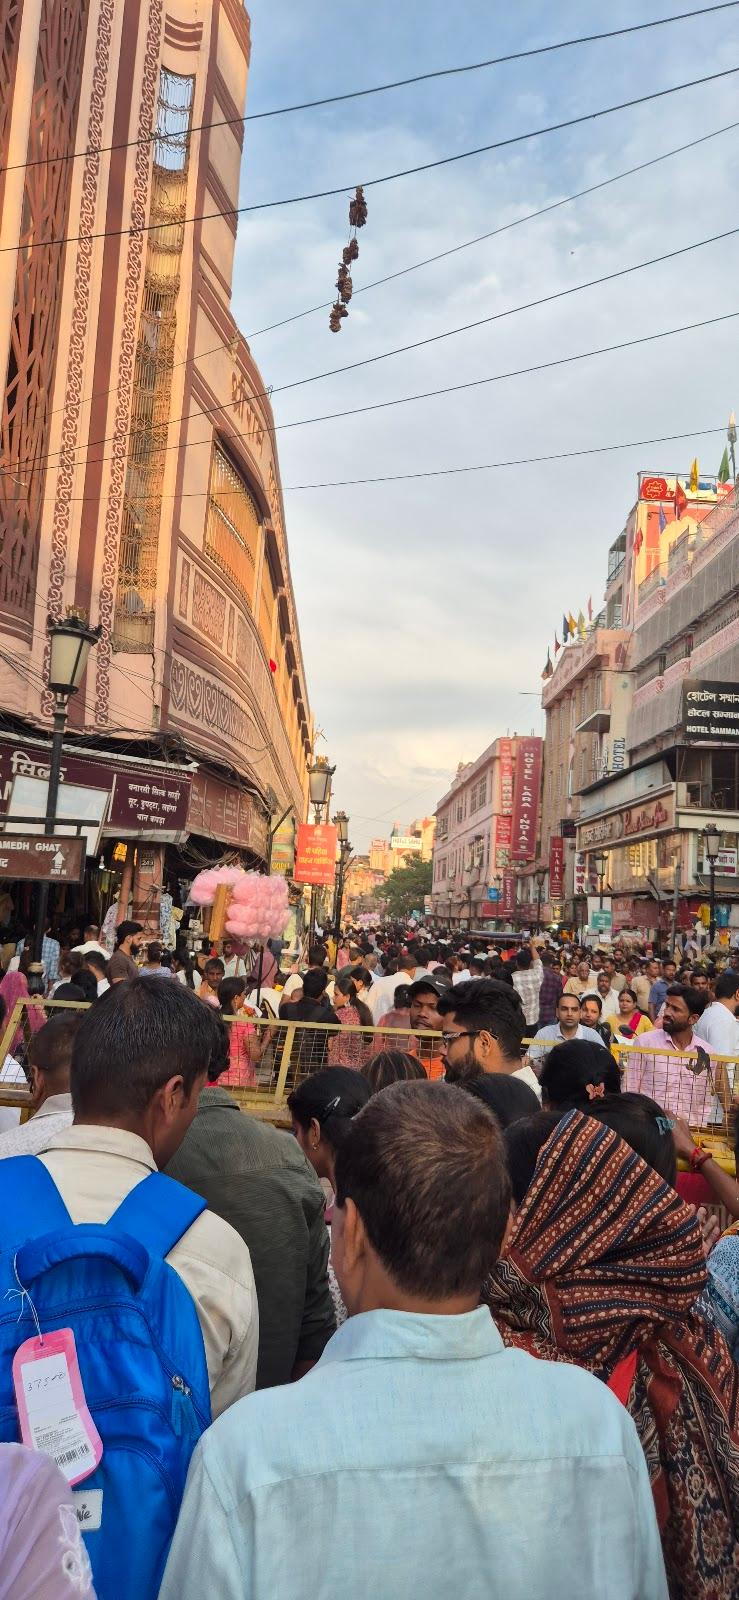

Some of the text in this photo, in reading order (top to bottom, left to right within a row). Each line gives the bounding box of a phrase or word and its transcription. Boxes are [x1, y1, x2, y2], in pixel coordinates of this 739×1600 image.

[686, 725, 709, 733] HOTEL
[612, 737, 625, 769] HOTEL
[523, 752, 534, 780] HOTEL
[521, 785, 532, 808] LARA
[518, 813, 530, 841] INDIA
[35, 842, 62, 852] GHAT
